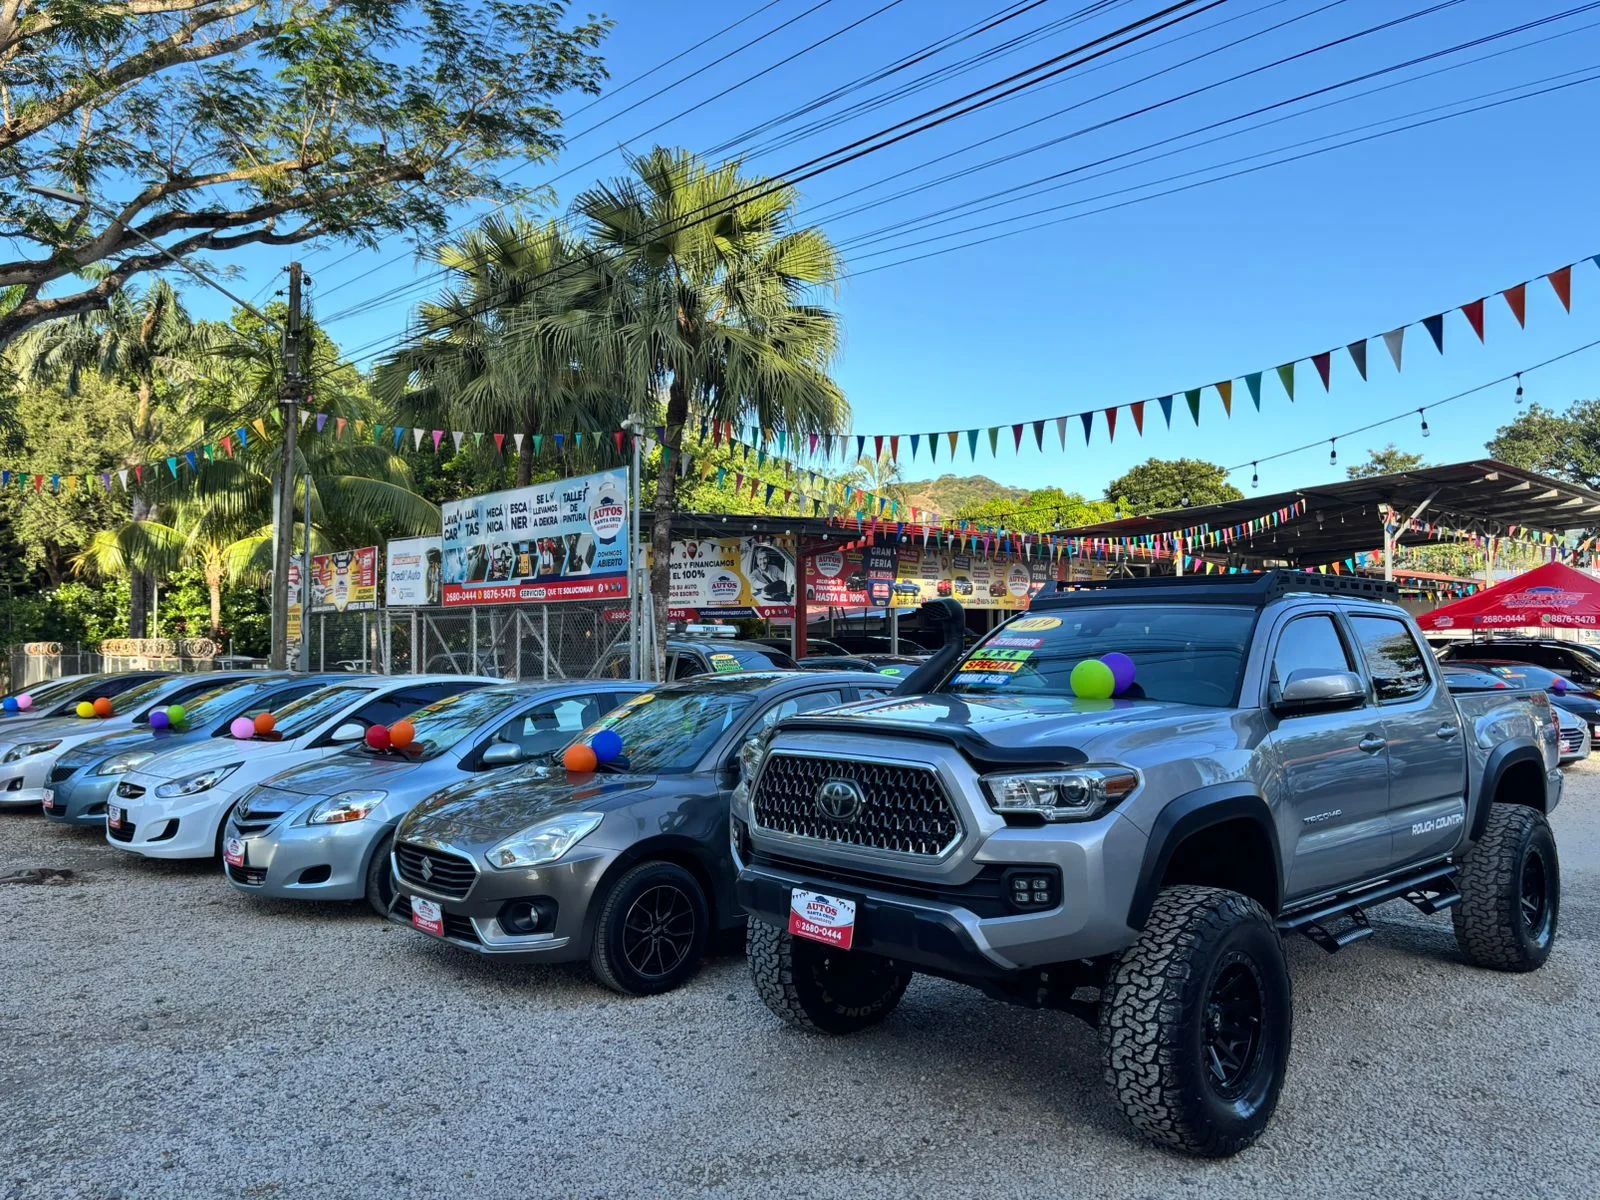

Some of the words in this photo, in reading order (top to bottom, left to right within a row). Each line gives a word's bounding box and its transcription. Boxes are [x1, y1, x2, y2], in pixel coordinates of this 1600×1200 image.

[536, 493, 545, 505] SE
[510, 502, 528, 514] ESCA
[532, 504, 558, 515] LLEVAMOS
[569, 503, 578, 513] DE
[593, 506, 623, 520] AUTOS
[465, 509, 479, 520] LLAN
[562, 513, 587, 523] PINTURA
[486, 520, 504, 533] NICA
[511, 516, 528, 530] NER
[533, 518, 539, 527] A
[538, 516, 559, 527] DEKRA
[594, 518, 609, 526] SANTA
[444, 528, 458, 541] CAR
[465, 522, 480, 536] TAS
[597, 549, 623, 558] DOMINGOS
[870, 547, 892, 556] GRAN
[597, 558, 623, 568] ABIERTO
[689, 559, 735, 569] FINANCIAMOS
[870, 558, 892, 568] FERIA
[672, 572, 681, 580] EL
[682, 570, 705, 579] 100%
[877, 570, 893, 578] AUTOS
[1008, 575, 1029, 583] AUTOS
[1032, 572, 1047, 581] FERIA
[711, 582, 738, 590] AUTOS
[446, 591, 477, 602] 2680-0444
[483, 588, 517, 600] 8876-5478
[521, 588, 545, 597] SERVICIOS
[547, 588, 557, 597] QUE
[563, 585, 594, 595] SOLUCIONAN
[815, 592, 839, 602] HASTA
[839, 593, 849, 602] EL
[849, 593, 866, 603] 100%
[1482, 614, 1526, 624] 2680-0444
[1551, 614, 1596, 624] 8876-5478
[965, 660, 1017, 671] SPECIAL
[954, 674, 988, 684] FAMILY
[984, 675, 1008, 684] SIZE
[1303, 809, 1343, 825] TACOMA
[1411, 820, 1435, 836] ROUGH
[1435, 813, 1464, 829] COUNTRY
[806, 902, 838, 916] AUTOS
[801, 922, 842, 940] 2680-0444
